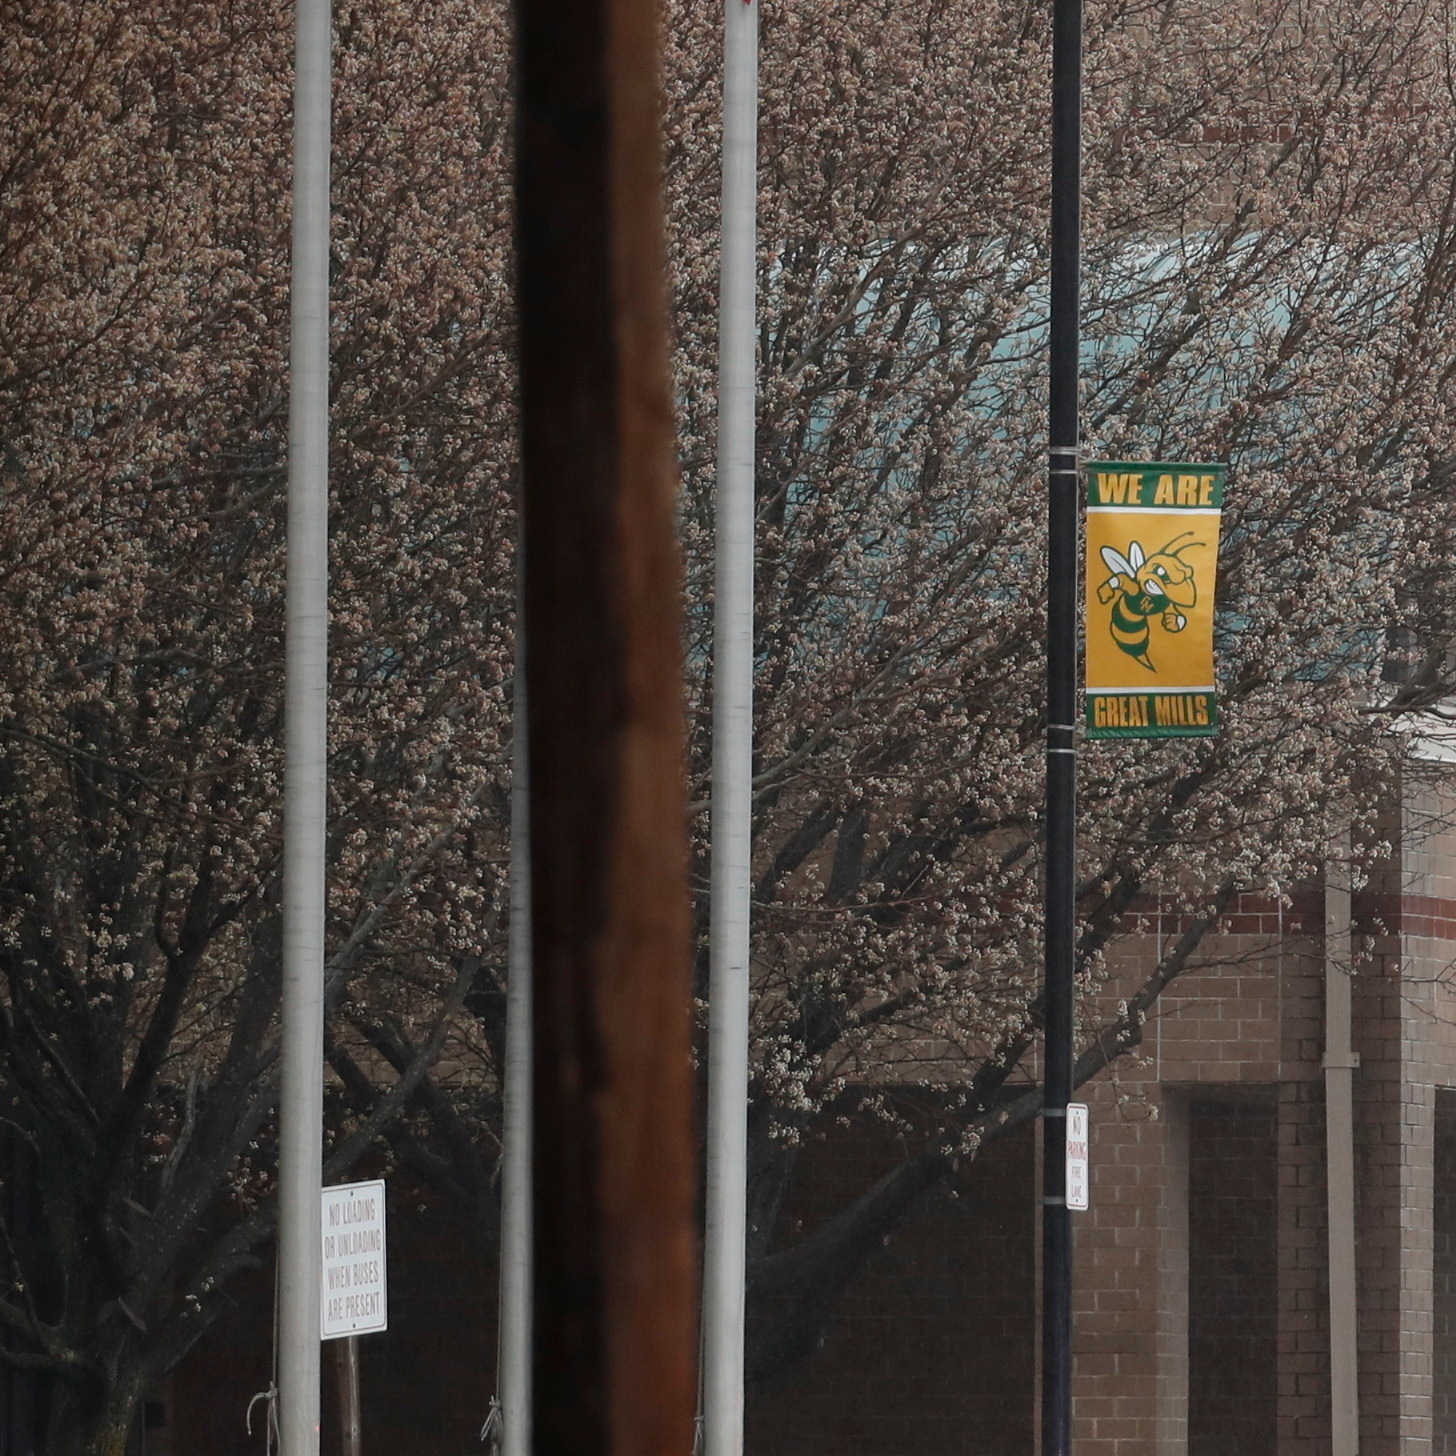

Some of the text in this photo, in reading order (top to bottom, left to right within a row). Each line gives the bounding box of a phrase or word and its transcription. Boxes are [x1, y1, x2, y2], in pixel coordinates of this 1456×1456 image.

[1097, 473, 1214, 506] WE ARE
[1094, 696, 1208, 727] GREAT MILLS
[329, 1198, 376, 1227] NO LOADING
[325, 1228, 381, 1259] OR UNLOADING
[328, 1260, 379, 1290] WHEN BUSES
[328, 1291, 380, 1321] ARE PRESENT
